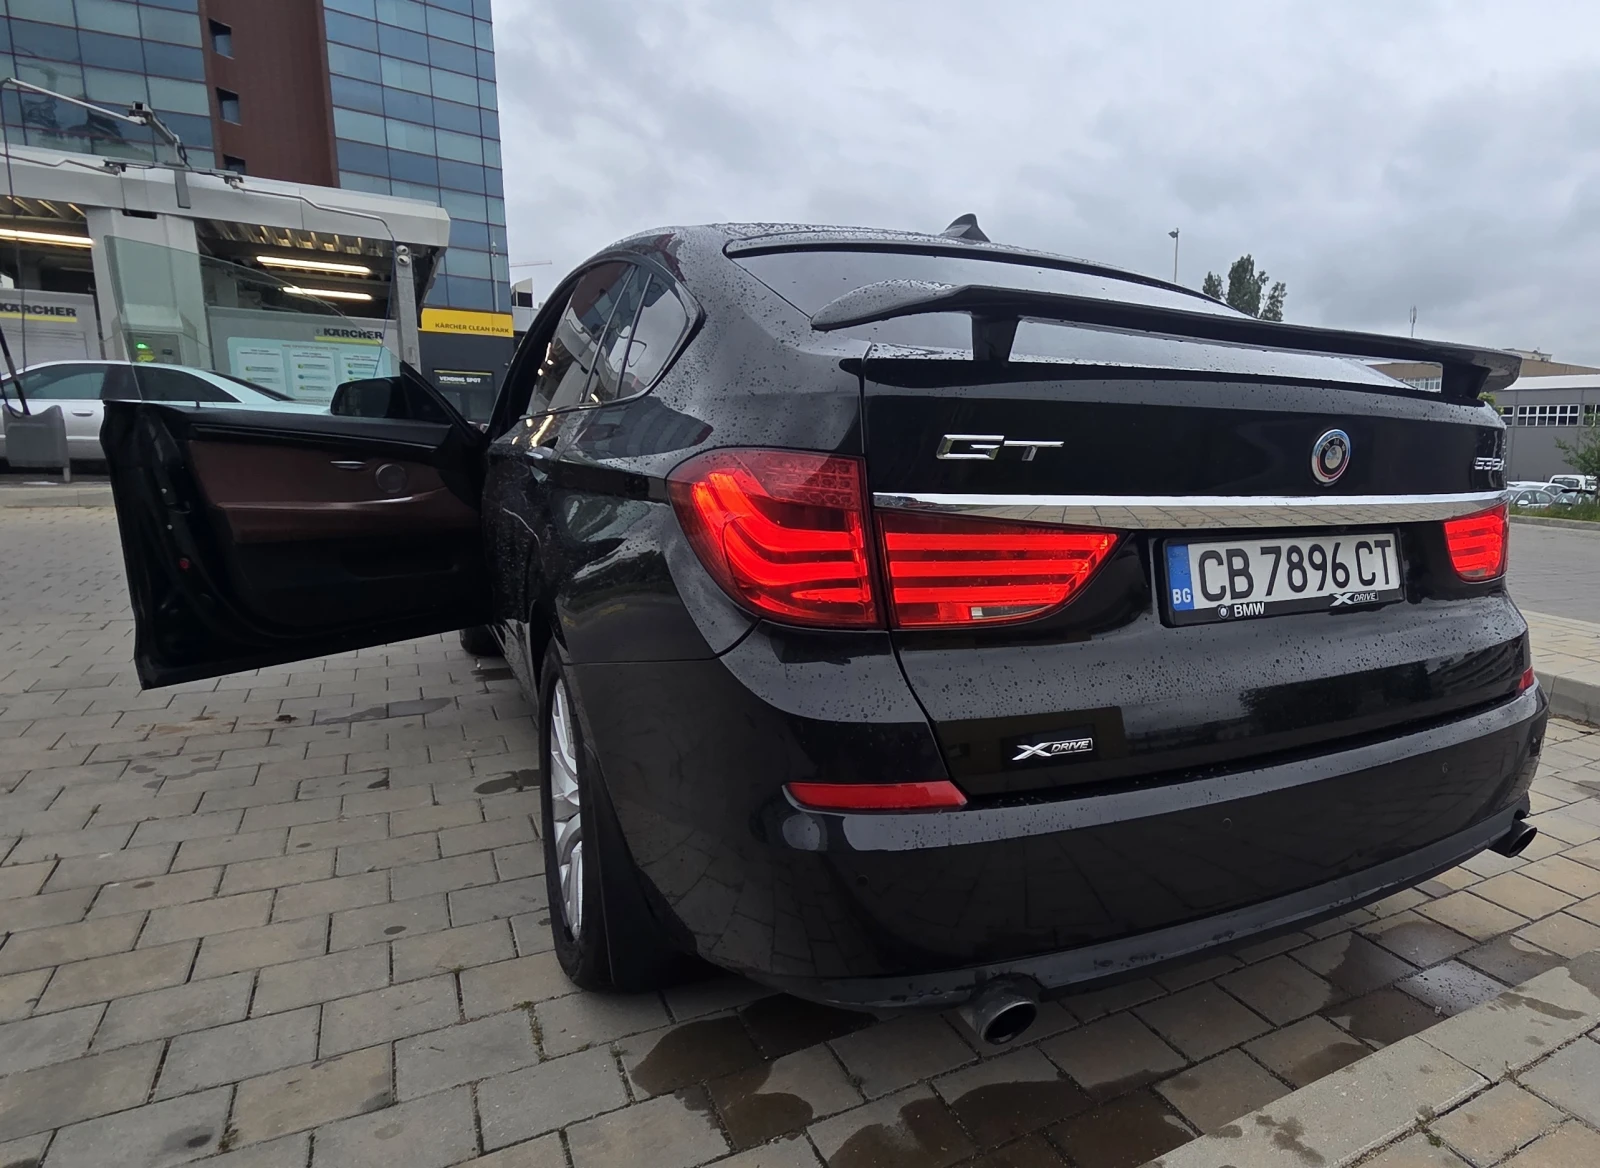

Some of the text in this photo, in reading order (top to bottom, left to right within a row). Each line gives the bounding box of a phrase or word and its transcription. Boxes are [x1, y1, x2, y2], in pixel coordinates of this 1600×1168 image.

[936, 434, 1065, 462] GT
[1199, 539, 1392, 603] CB 7896 CT
[1172, 588, 1193, 605] BG
[1233, 602, 1266, 618] BMW
